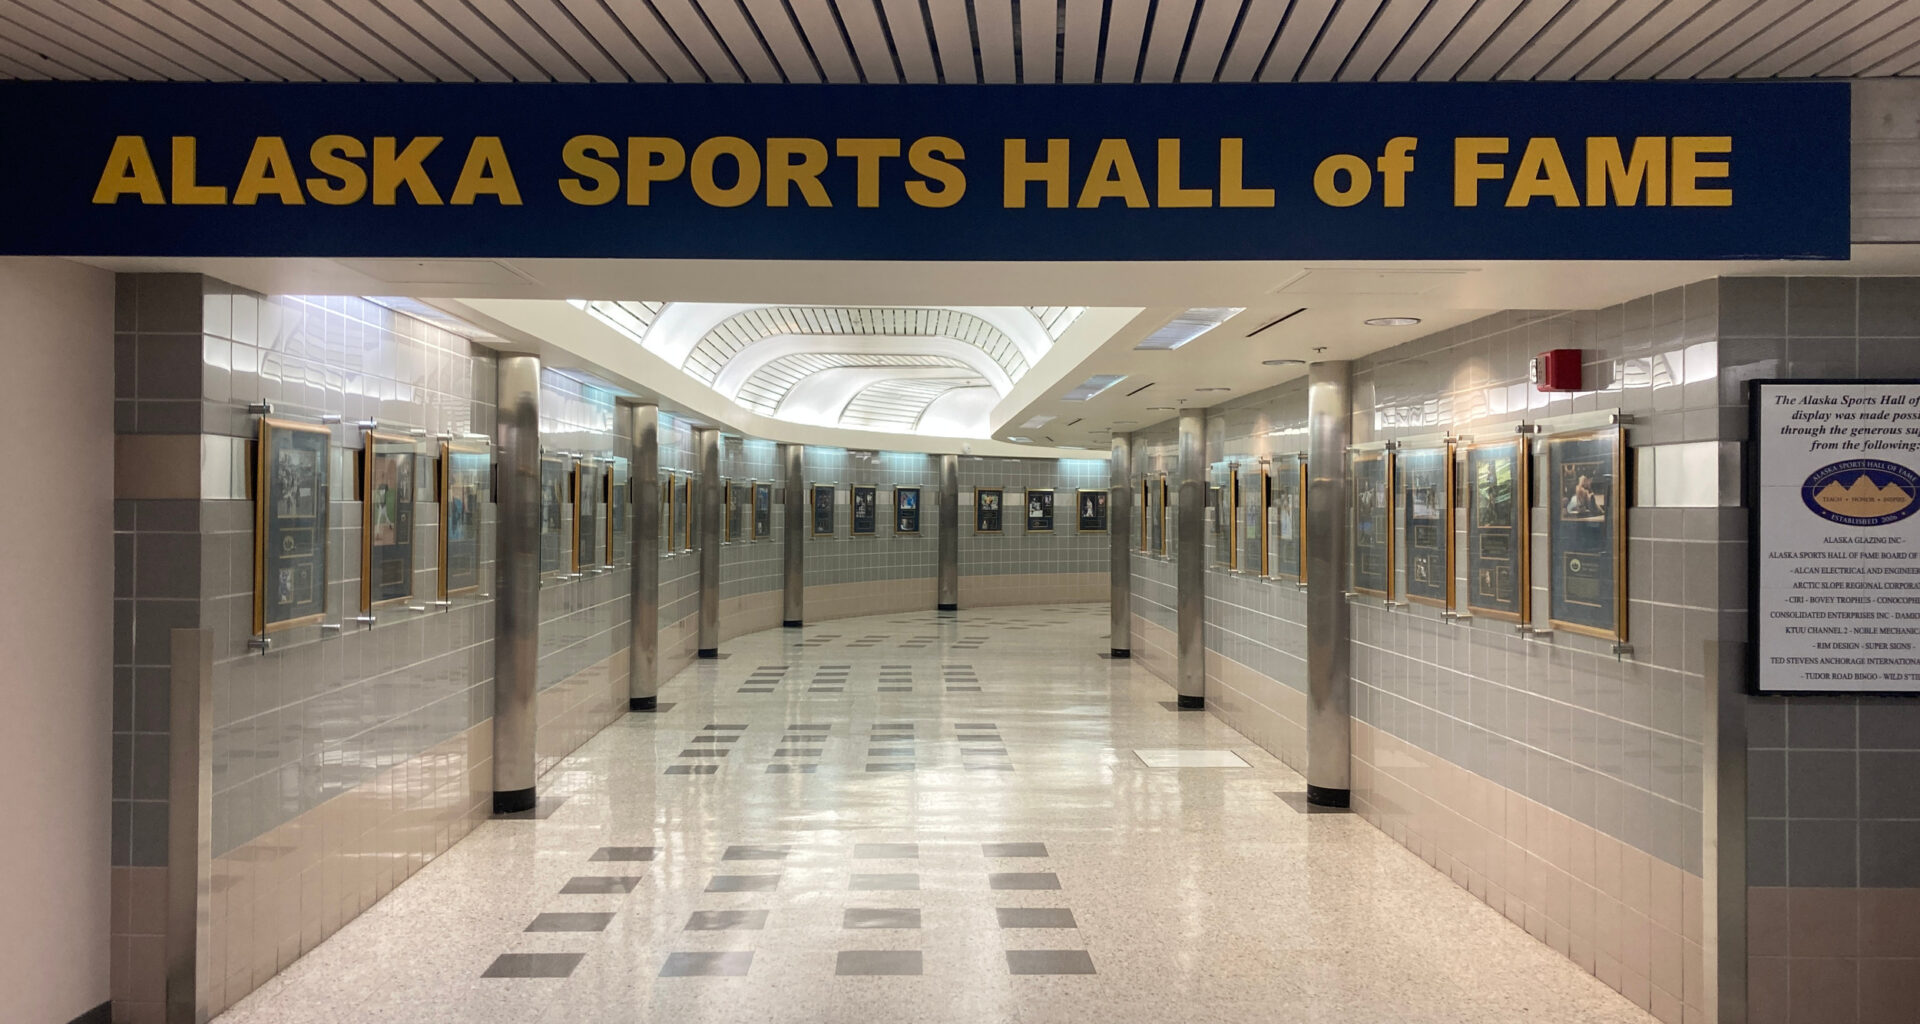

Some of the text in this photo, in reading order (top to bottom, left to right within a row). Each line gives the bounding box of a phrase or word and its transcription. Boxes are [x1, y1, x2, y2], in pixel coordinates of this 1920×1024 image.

[92, 134, 1732, 209] ALASKA SPORTS HALL of FAME
[1775, 395, 1799, 405] The
[1799, 395, 1838, 405] Alaska
[1840, 395, 1876, 407] Sports
[1880, 395, 1906, 405] Hall
[1792, 410, 1832, 422] display
[1835, 412, 1856, 420] was
[1860, 410, 1890, 420] made
[1781, 425, 1826, 437] through
[1830, 425, 1848, 435] the
[1850, 427, 1902, 437] generous
[1809, 440, 1838, 452] from
[1842, 440, 1860, 450] the
[1813, 460, 1917, 482] ALASKA SPORTS HALL OF FAME
[1831, 514, 1878, 525] ESTABLISHED
